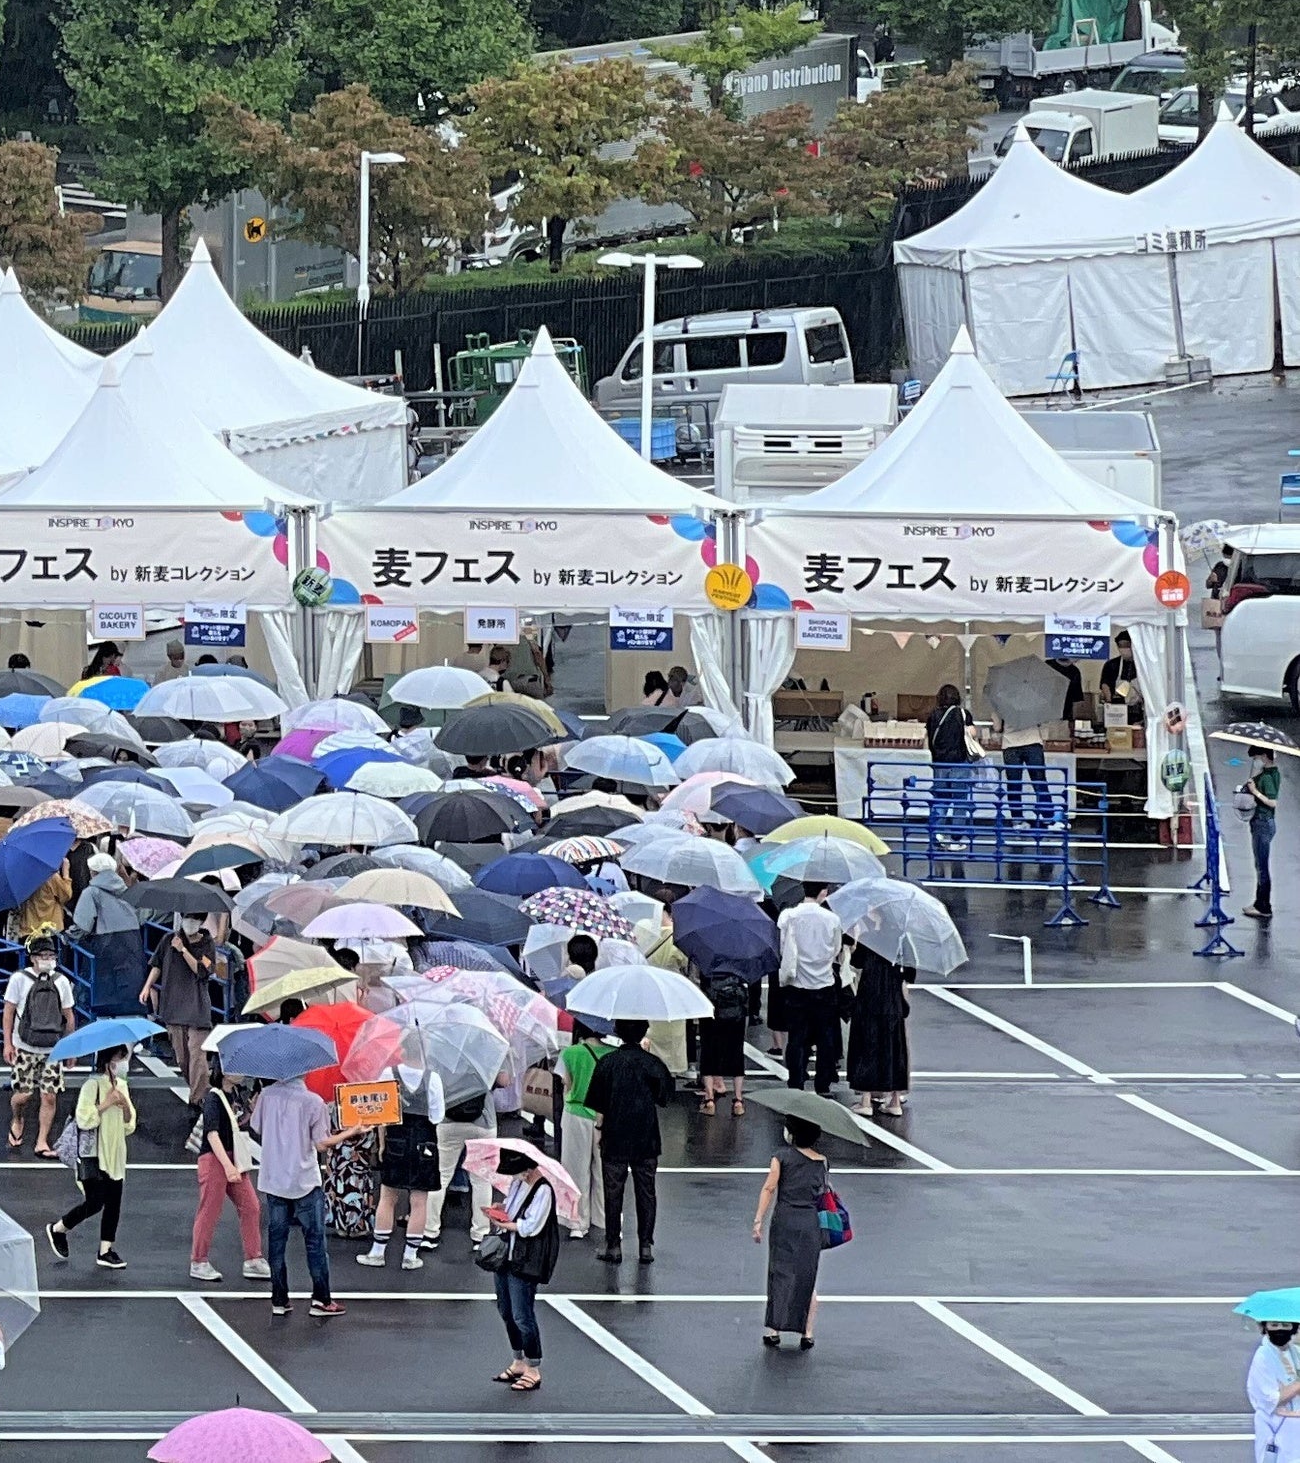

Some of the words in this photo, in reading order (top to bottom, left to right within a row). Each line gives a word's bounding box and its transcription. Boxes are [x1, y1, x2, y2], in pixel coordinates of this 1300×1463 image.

[772, 62, 841, 90] Distribution
[1137, 229, 1206, 253] ゴミ集積所
[48, 518, 89, 528] INSPIRE
[469, 520, 511, 530] INSPIRE
[903, 526, 947, 536] INSPIRE
[372, 548, 521, 587] 麦フェス
[534, 569, 551, 586] by
[558, 569, 683, 586] 新麦コレクション
[803, 553, 957, 593] 麦フェス
[970, 576, 988, 593] by
[996, 576, 1124, 593] 新麦コレクション
[111, 566, 128, 582] by
[135, 566, 255, 582] 新麦コレクション
[98, 612, 138, 620] CICOUTE
[100, 621, 136, 629] BAKERY
[350, 1092, 389, 1105] 最後尾は
[357, 1104, 384, 1114] こちら
